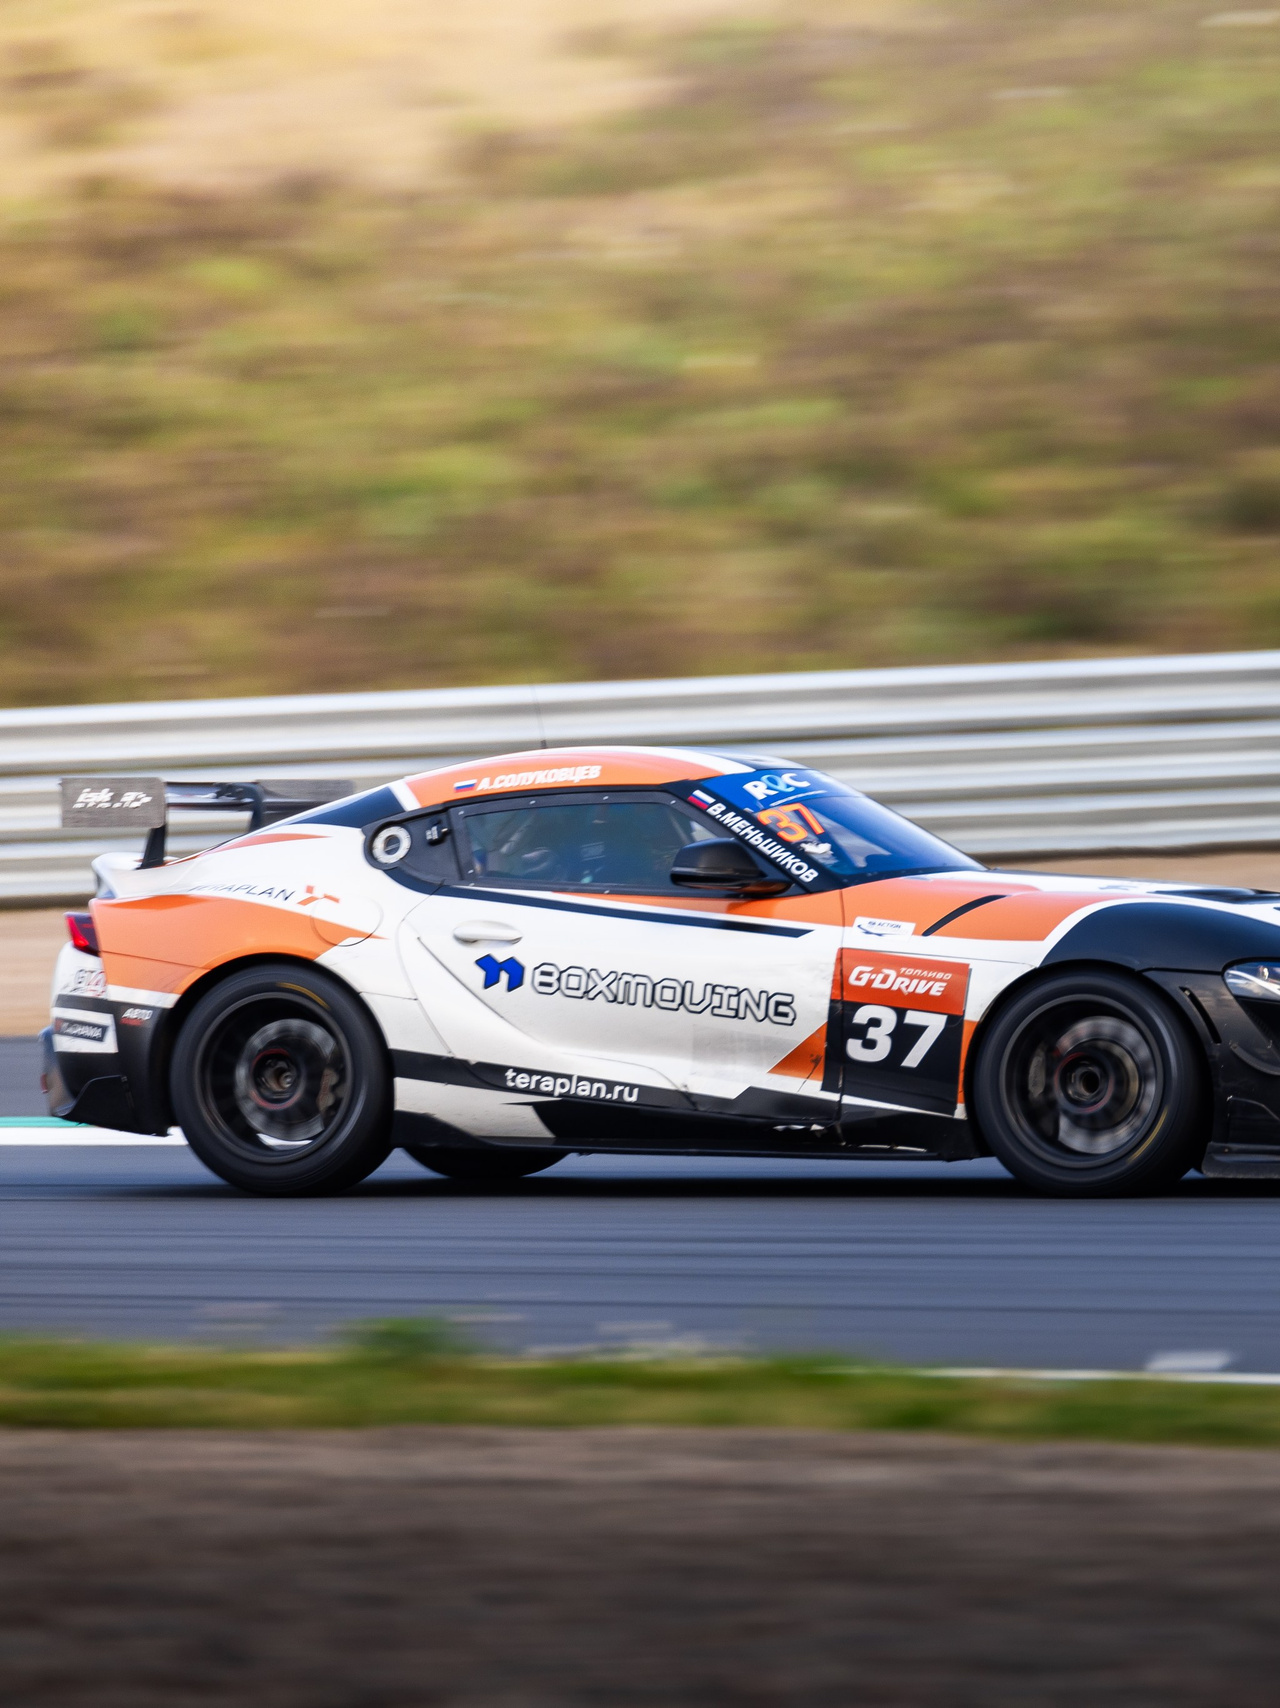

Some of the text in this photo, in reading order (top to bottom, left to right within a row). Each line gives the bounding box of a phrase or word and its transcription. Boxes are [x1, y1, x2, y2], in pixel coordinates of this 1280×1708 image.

[706, 803, 819, 883] В.МЕНЬШИКОВ
[757, 802, 825, 843] 37
[531, 962, 797, 1026] BOXMOVING
[846, 1004, 948, 1069] 37
[505, 1068, 639, 1103] teraplan.ru
